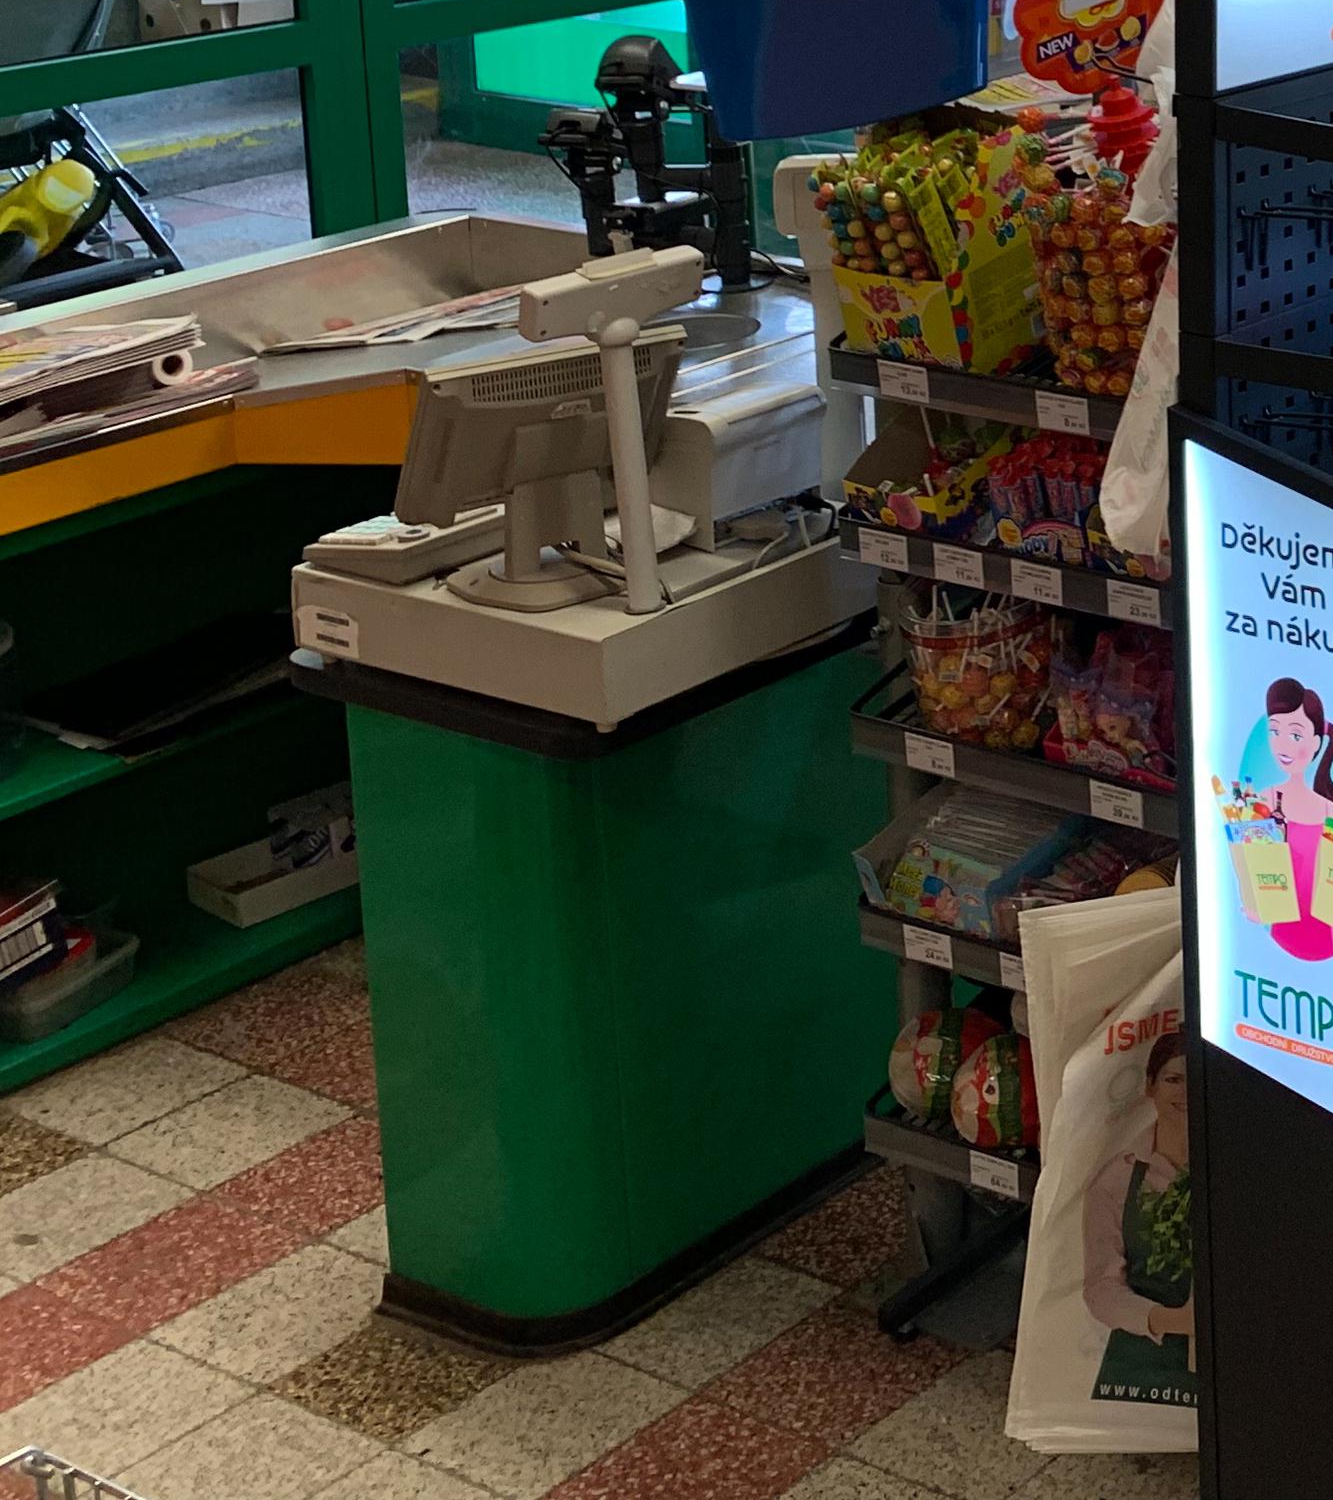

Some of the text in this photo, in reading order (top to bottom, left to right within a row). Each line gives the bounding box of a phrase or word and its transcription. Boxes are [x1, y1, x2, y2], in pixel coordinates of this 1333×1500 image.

[1039, 33, 1073, 59] NEW
[1260, 572, 1326, 610] Vám
[1225, 610, 1258, 637] za
[1256, 873, 1288, 886] TEMPO
[1104, 1008, 1180, 1055] JSME
[1241, 1026, 1288, 1050] OBCHODNÍ
